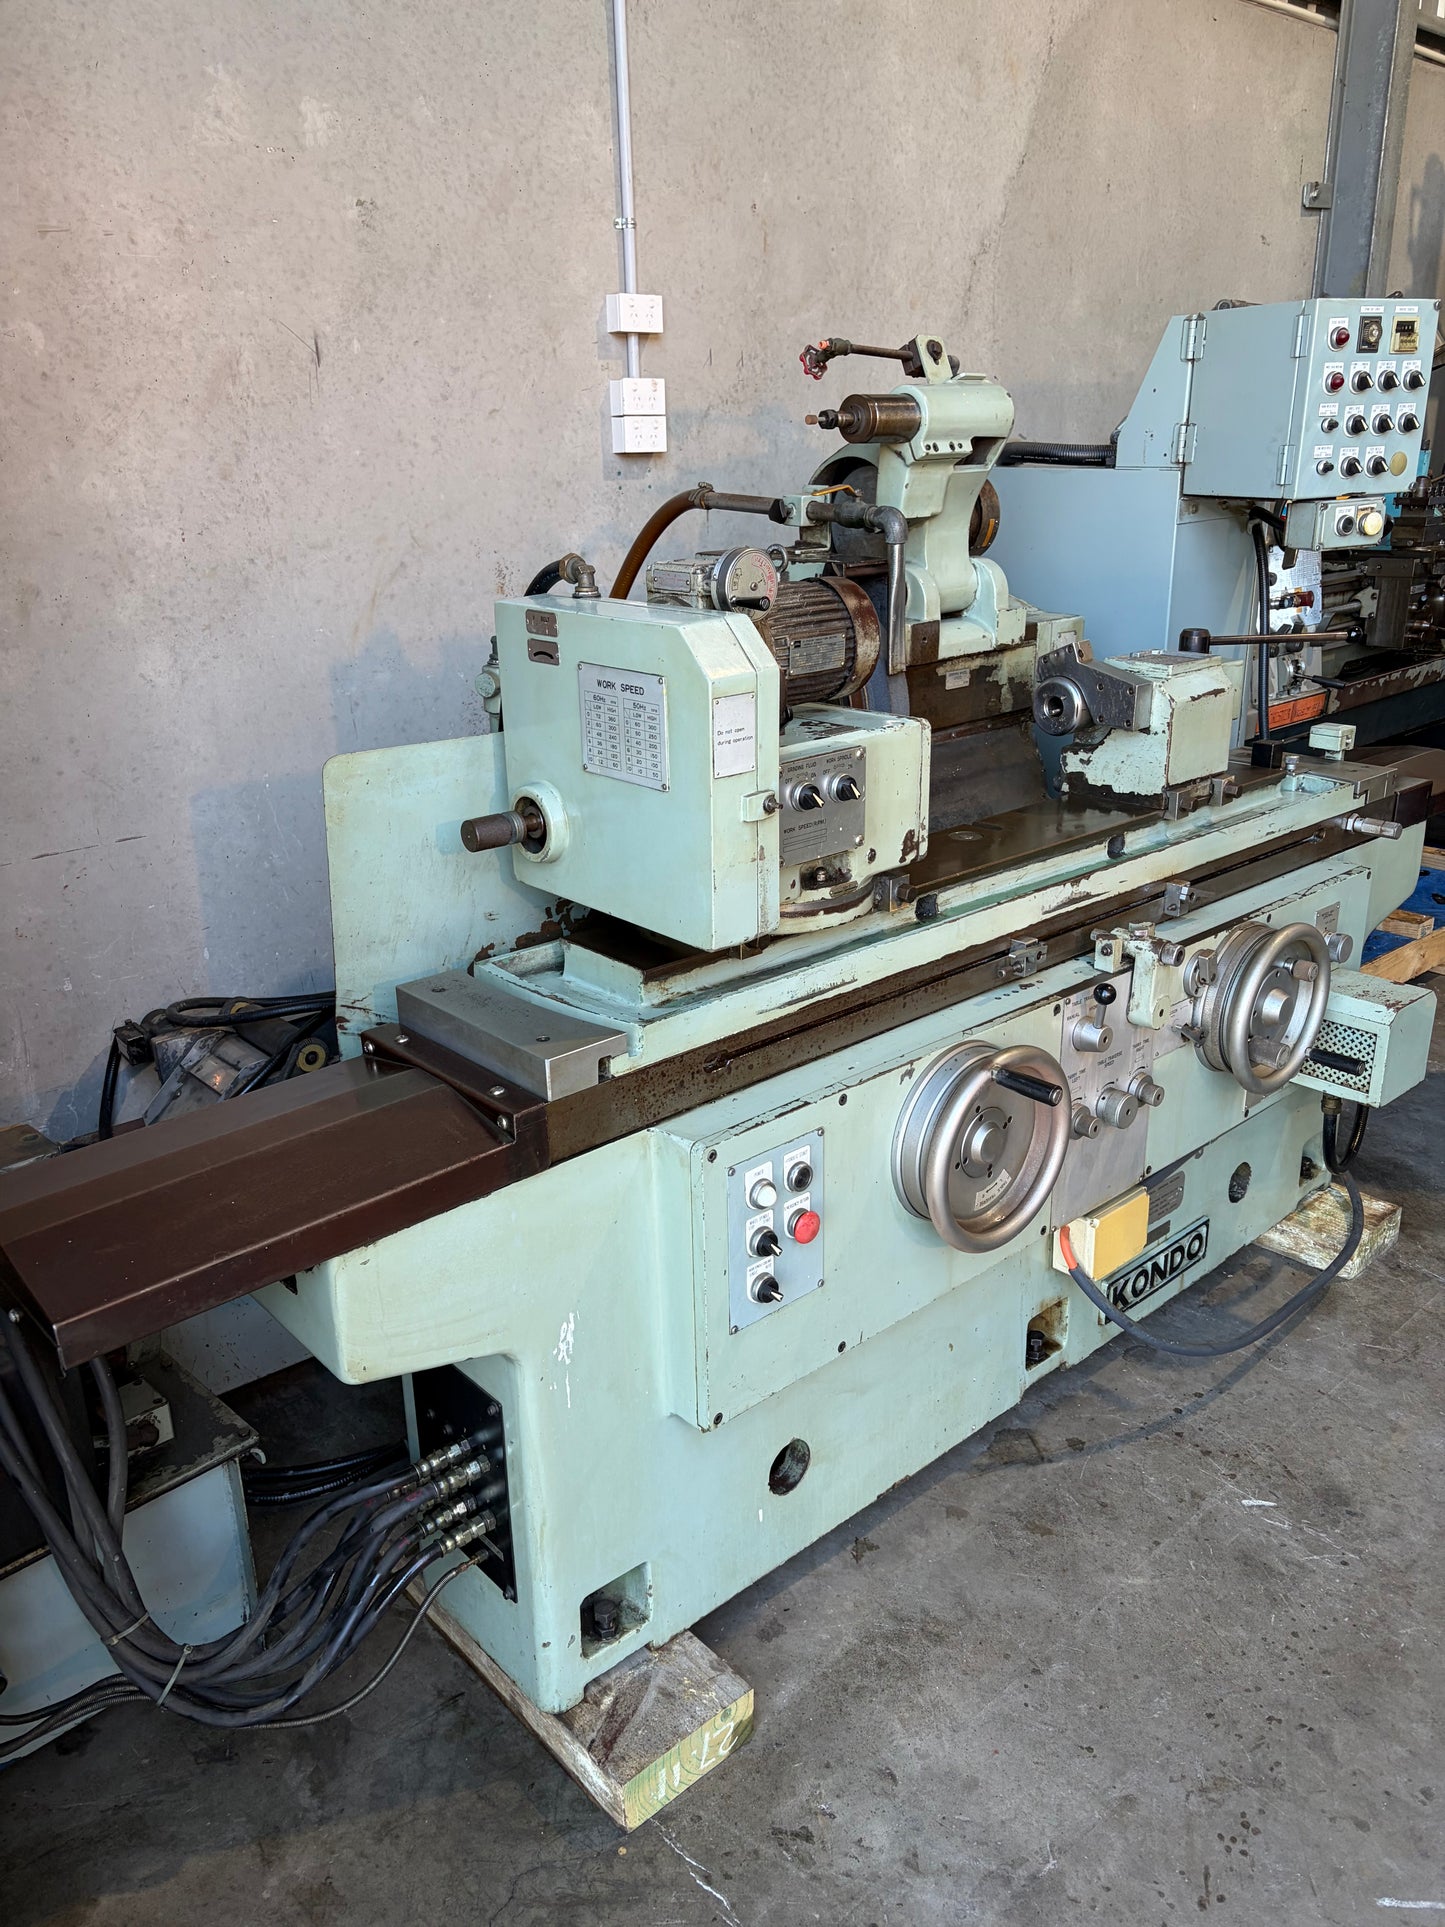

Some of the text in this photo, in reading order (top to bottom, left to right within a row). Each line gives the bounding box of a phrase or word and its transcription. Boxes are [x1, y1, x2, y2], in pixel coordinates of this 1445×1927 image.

[596, 679, 644, 696] WORK SPEED
[732, 735, 753, 743] operation
[1112, 1233, 1203, 1307] KONDO
